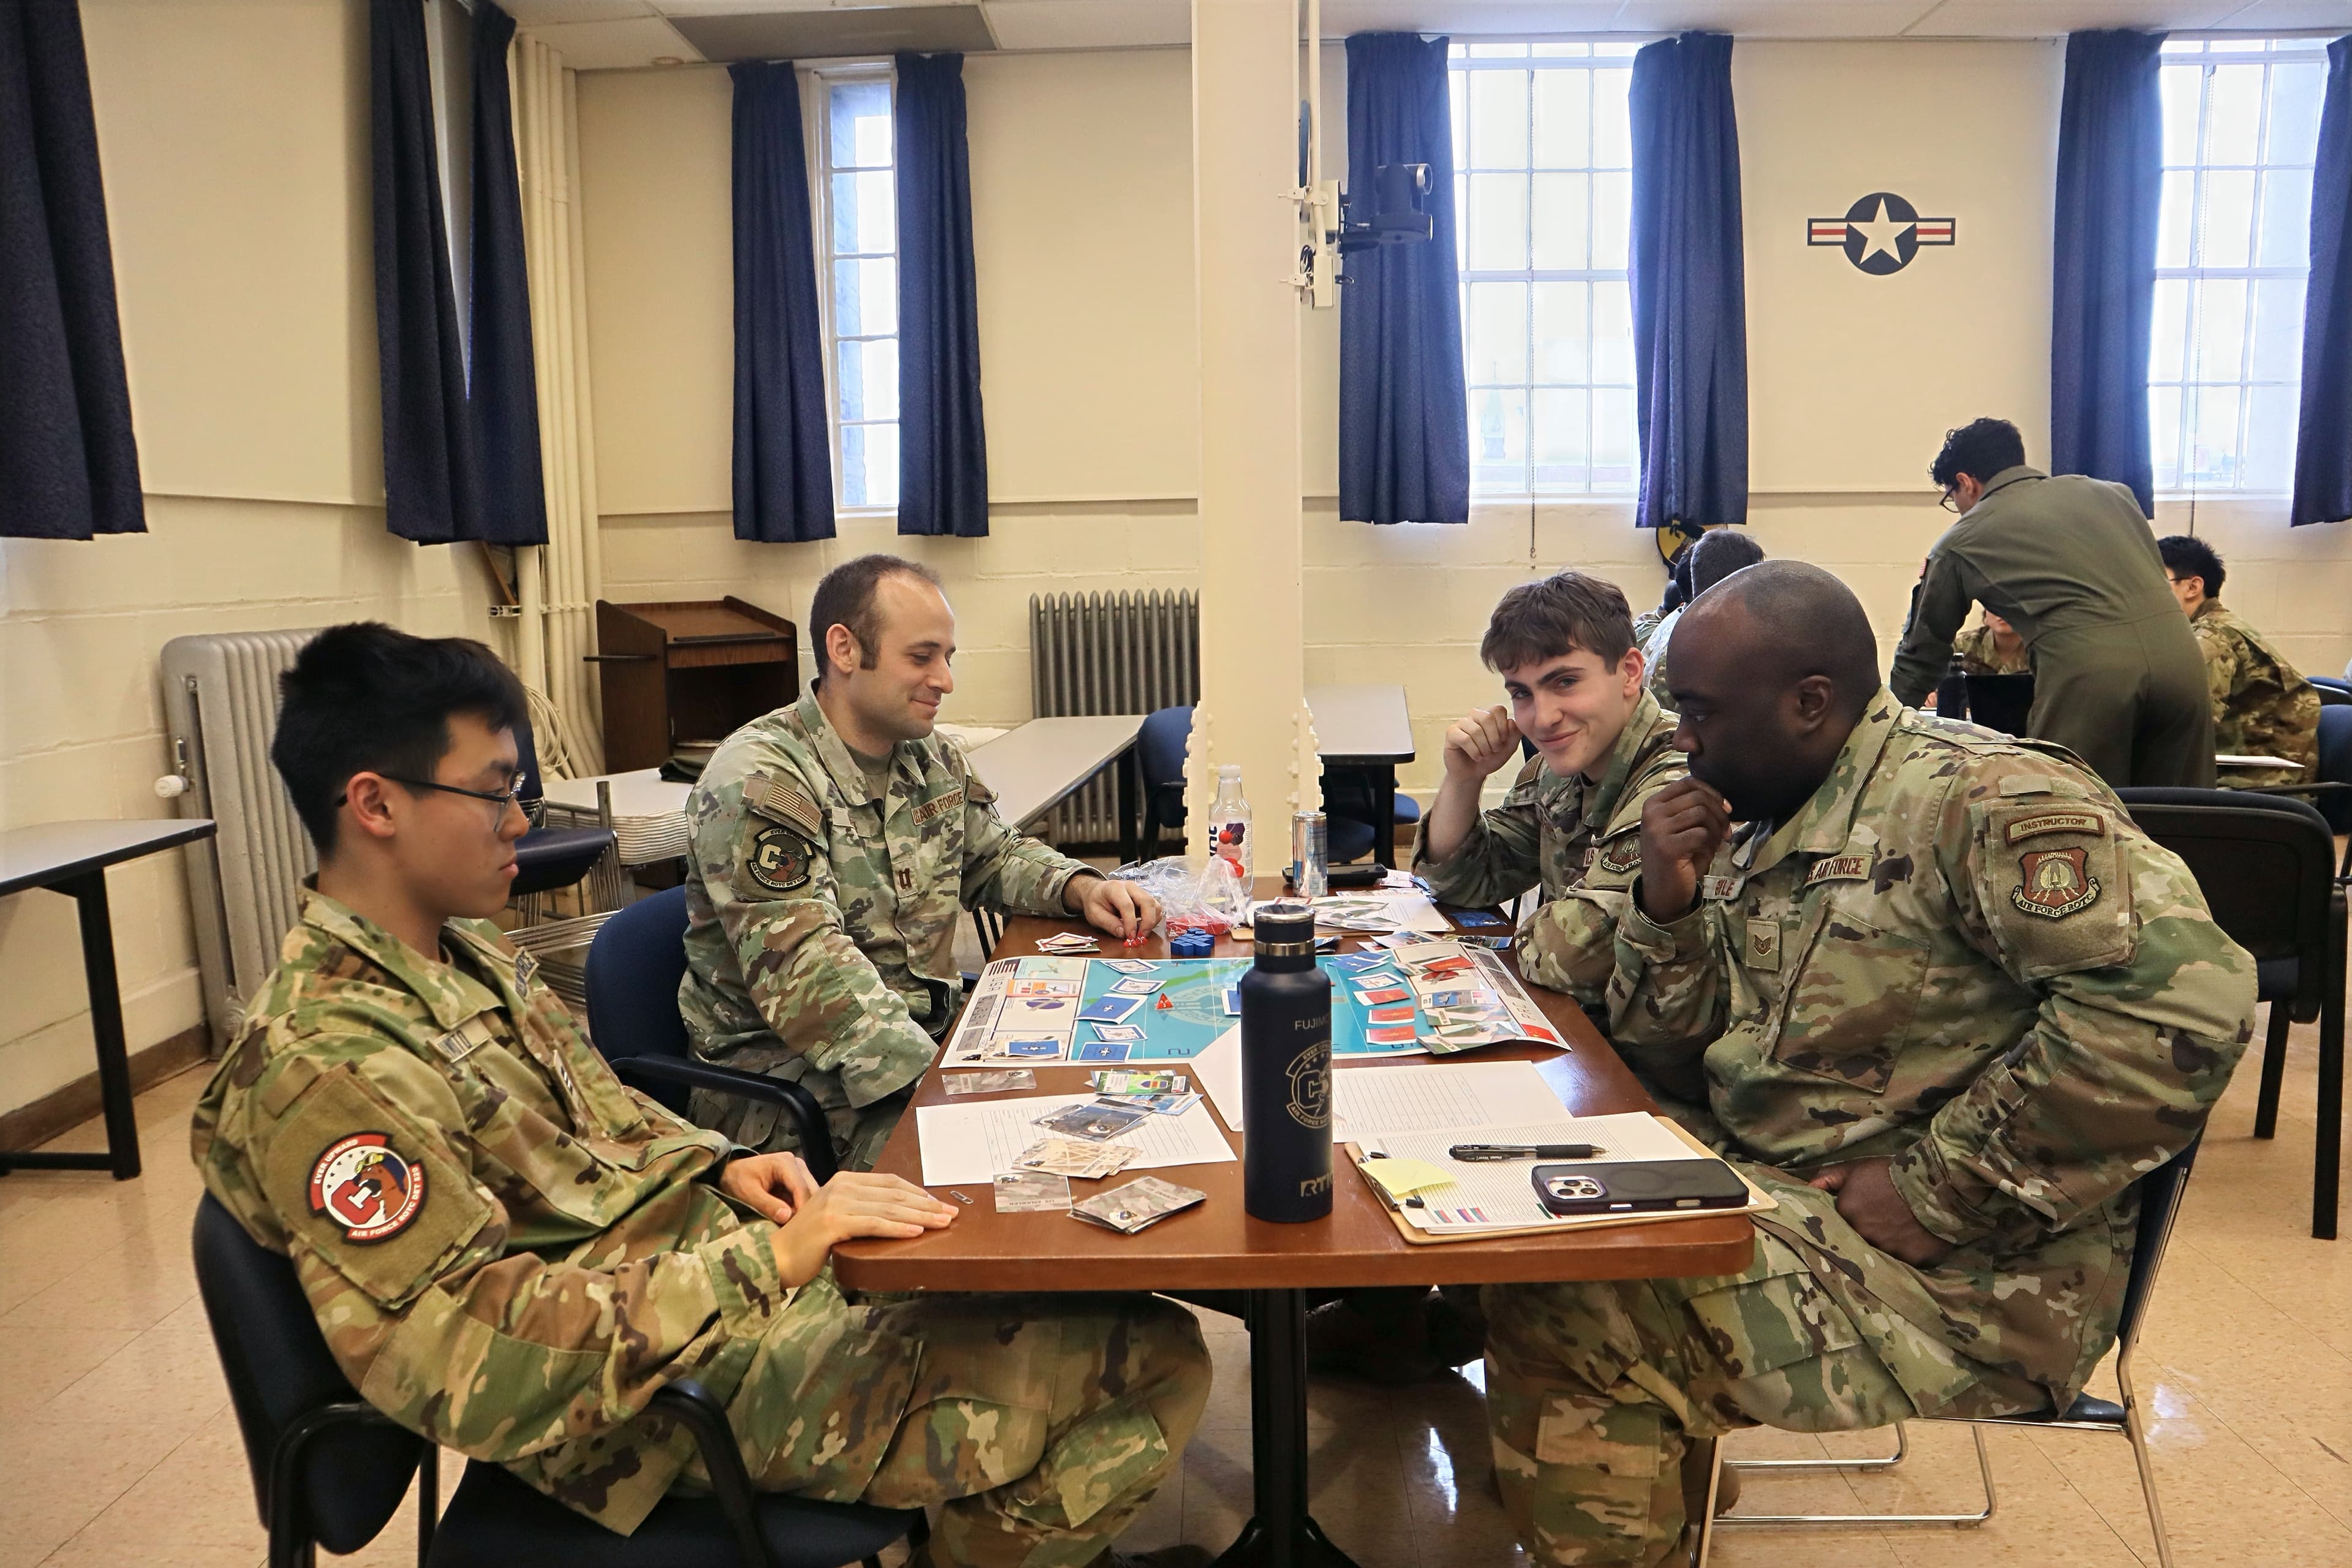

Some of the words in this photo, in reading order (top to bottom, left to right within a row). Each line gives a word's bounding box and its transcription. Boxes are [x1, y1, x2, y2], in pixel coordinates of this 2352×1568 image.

[918, 803, 938, 821] AIR
[938, 791, 963, 812] FORCE
[2020, 818, 2087, 832] INSTRUCTOR
[1829, 858, 1865, 876] FORCE
[755, 870, 771, 885] FORCE
[2018, 899, 2033, 910] AIR
[2034, 902, 2067, 917] FORCE
[2068, 894, 2094, 911] ROTC
[1303, 1047, 1318, 1060] EVER
[1291, 1106, 1300, 1118] AIR
[1300, 1116, 1319, 1126] FORCE
[314, 1163, 327, 1185] EVER
[326, 1139, 358, 1163] UPWARD
[369, 1219, 399, 1237] FORCE
[399, 1200, 417, 1221] ROTC
[412, 1184, 423, 1201] DET
